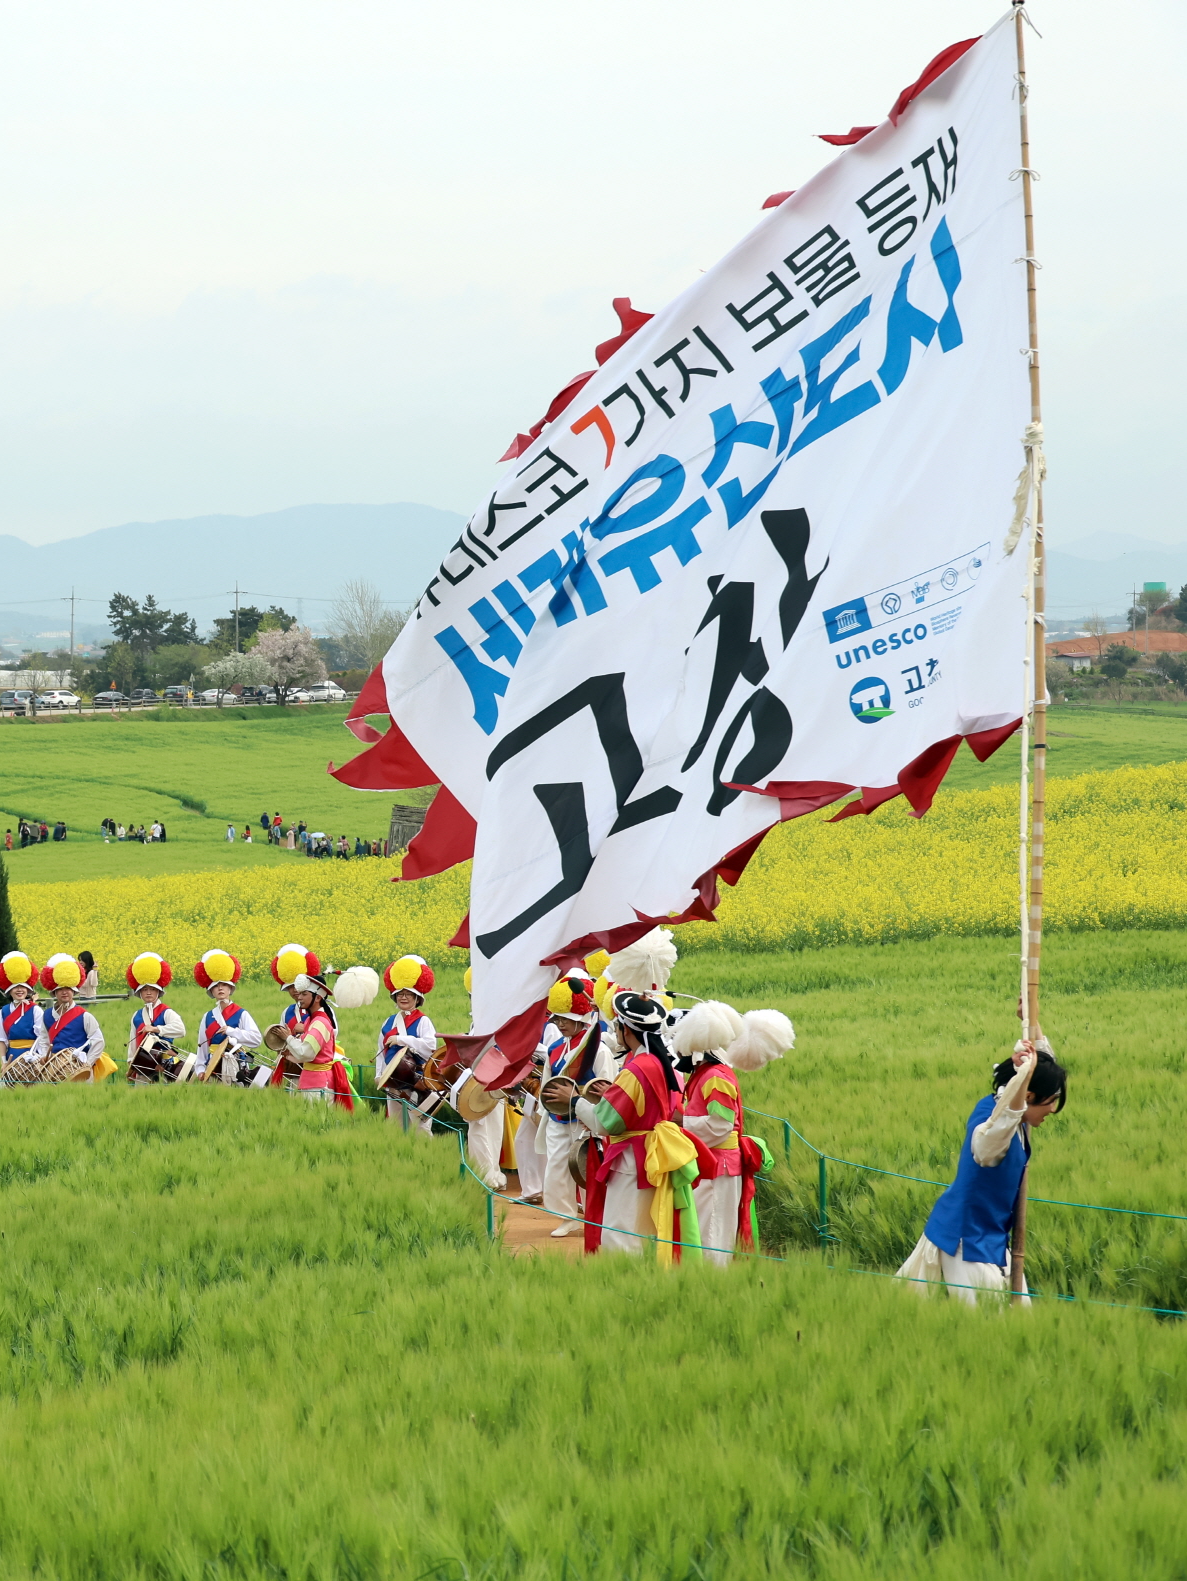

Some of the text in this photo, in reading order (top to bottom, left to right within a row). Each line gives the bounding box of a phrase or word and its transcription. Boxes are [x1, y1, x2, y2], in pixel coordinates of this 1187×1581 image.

[433, 214, 964, 737] 세계유산도시
[570, 325, 734, 471] 7가지
[725, 224, 861, 353] 보물
[855, 126, 959, 257] 등재
[475, 507, 830, 960] 고창
[835, 623, 928, 669] unesco
